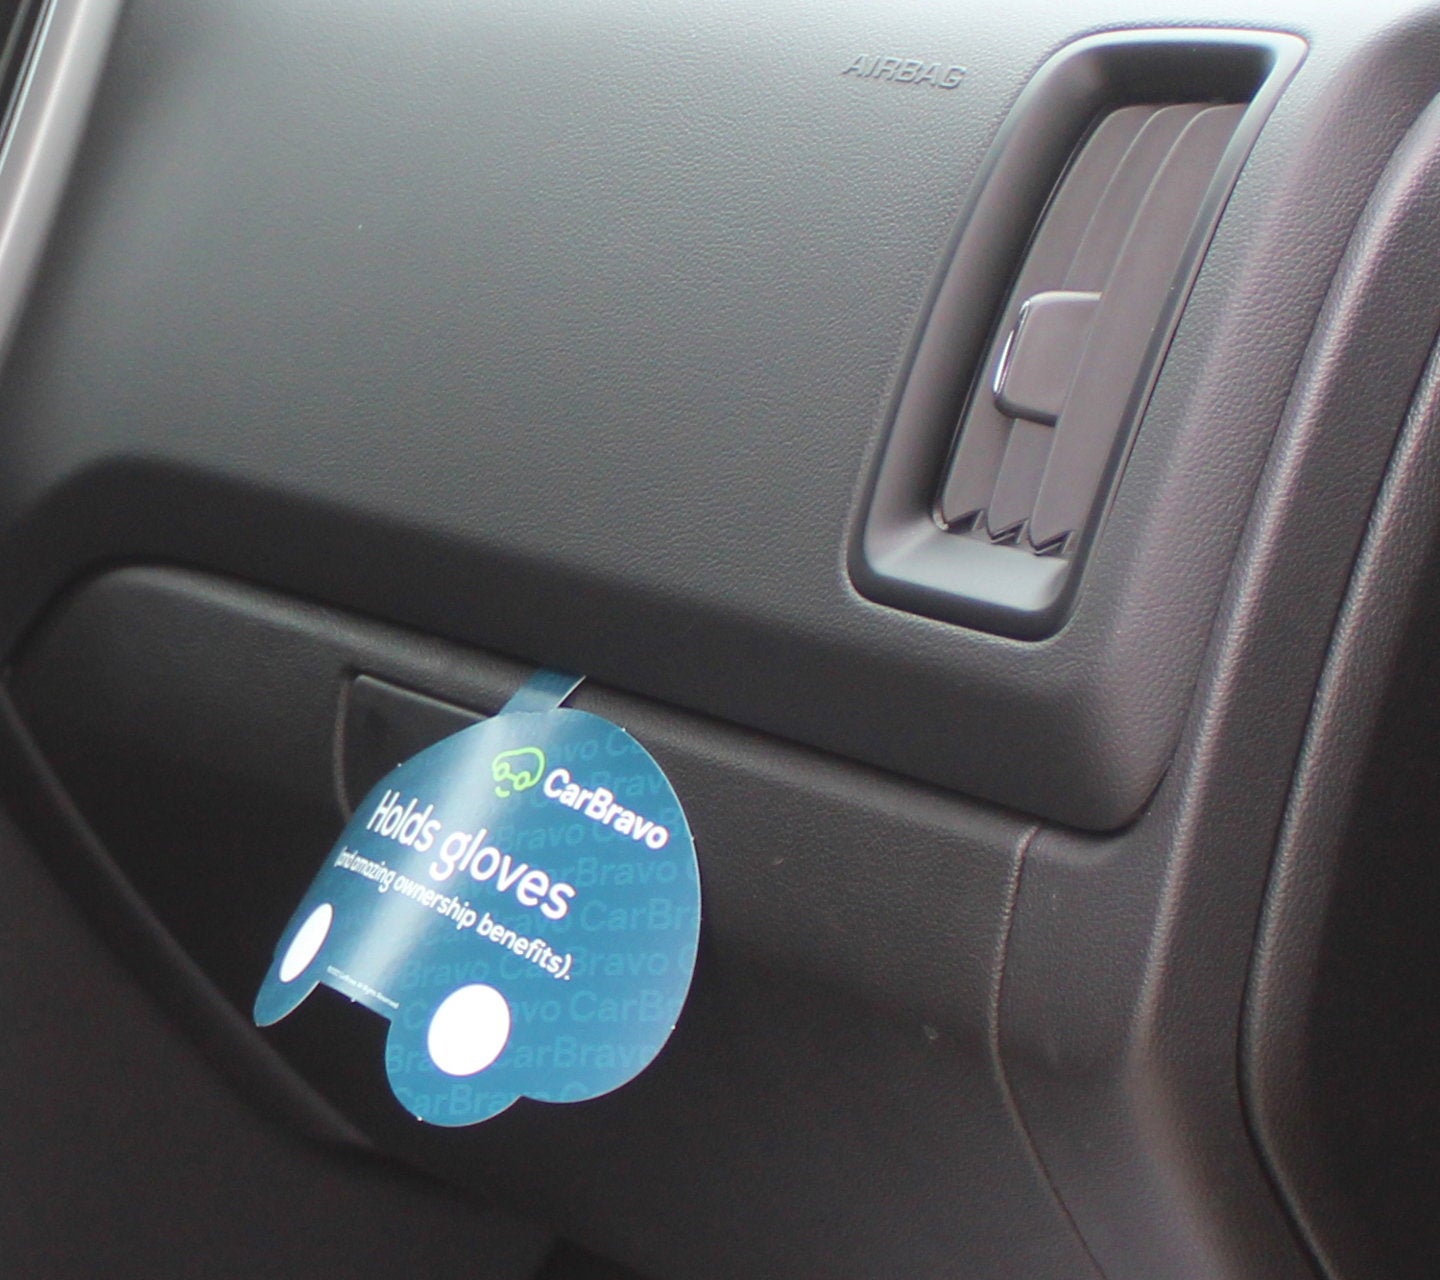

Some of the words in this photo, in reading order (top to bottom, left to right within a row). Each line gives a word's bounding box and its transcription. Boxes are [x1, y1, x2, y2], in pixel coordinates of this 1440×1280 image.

[841, 53, 967, 90] AIRBAG
[366, 788, 442, 852] Holds
[429, 828, 577, 920] gloves
[543, 768, 669, 850] CarBravo
[352, 856, 396, 893] amazing
[393, 875, 477, 930] ownership
[475, 912, 572, 981] benefits).
